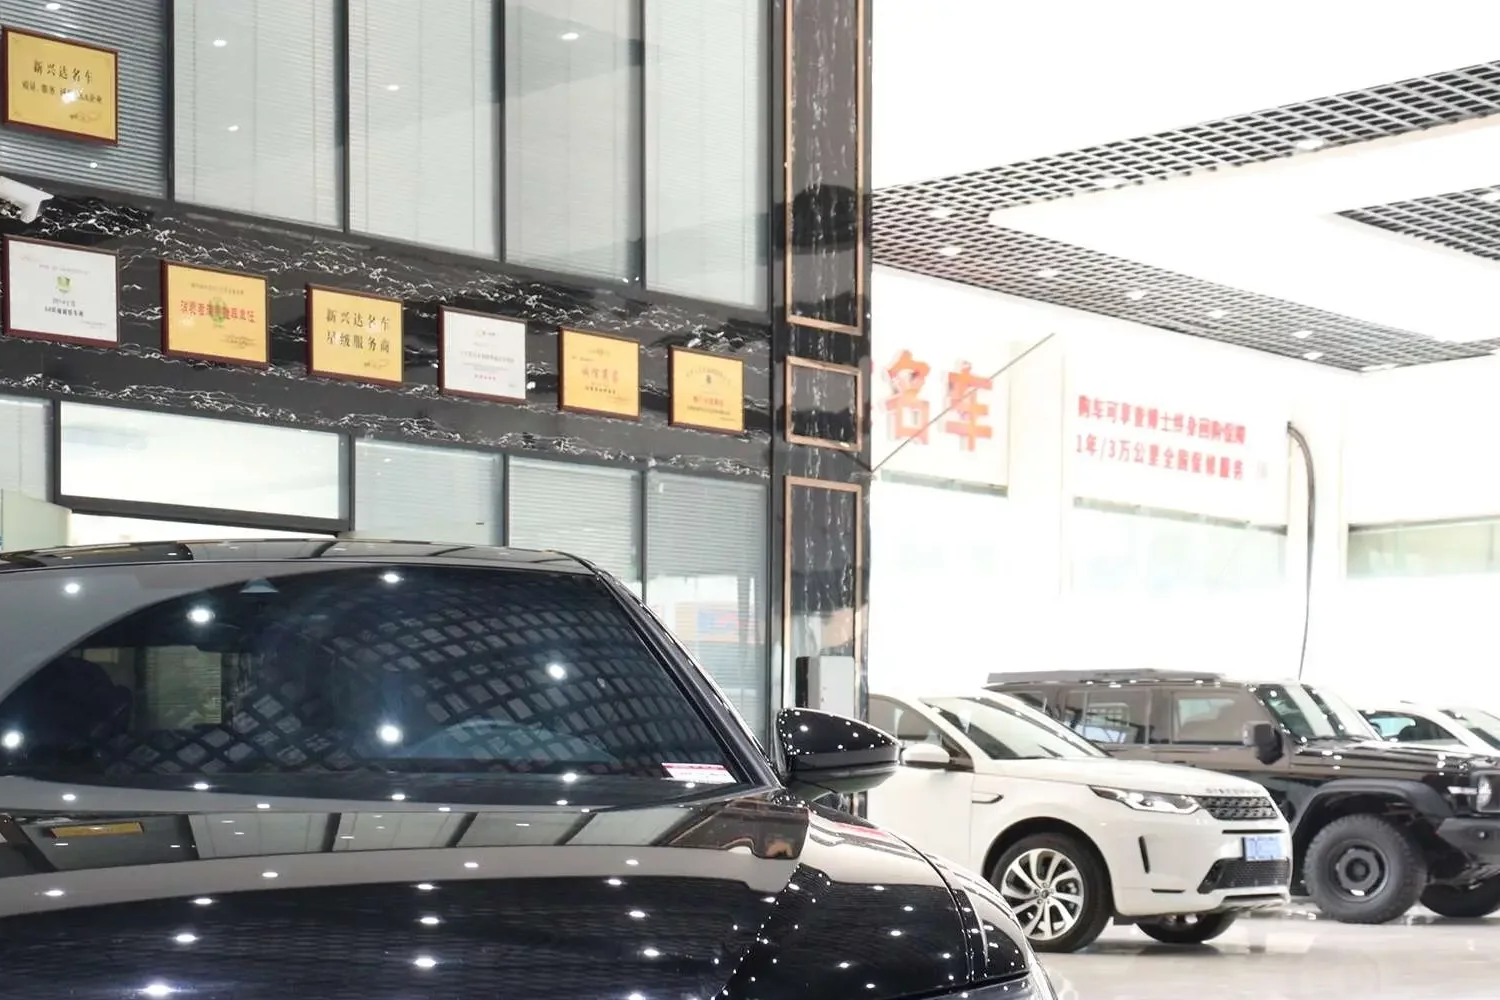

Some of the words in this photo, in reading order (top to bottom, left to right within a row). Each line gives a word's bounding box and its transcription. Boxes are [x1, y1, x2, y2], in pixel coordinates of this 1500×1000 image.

[326, 330, 390, 353] 星级服务商
